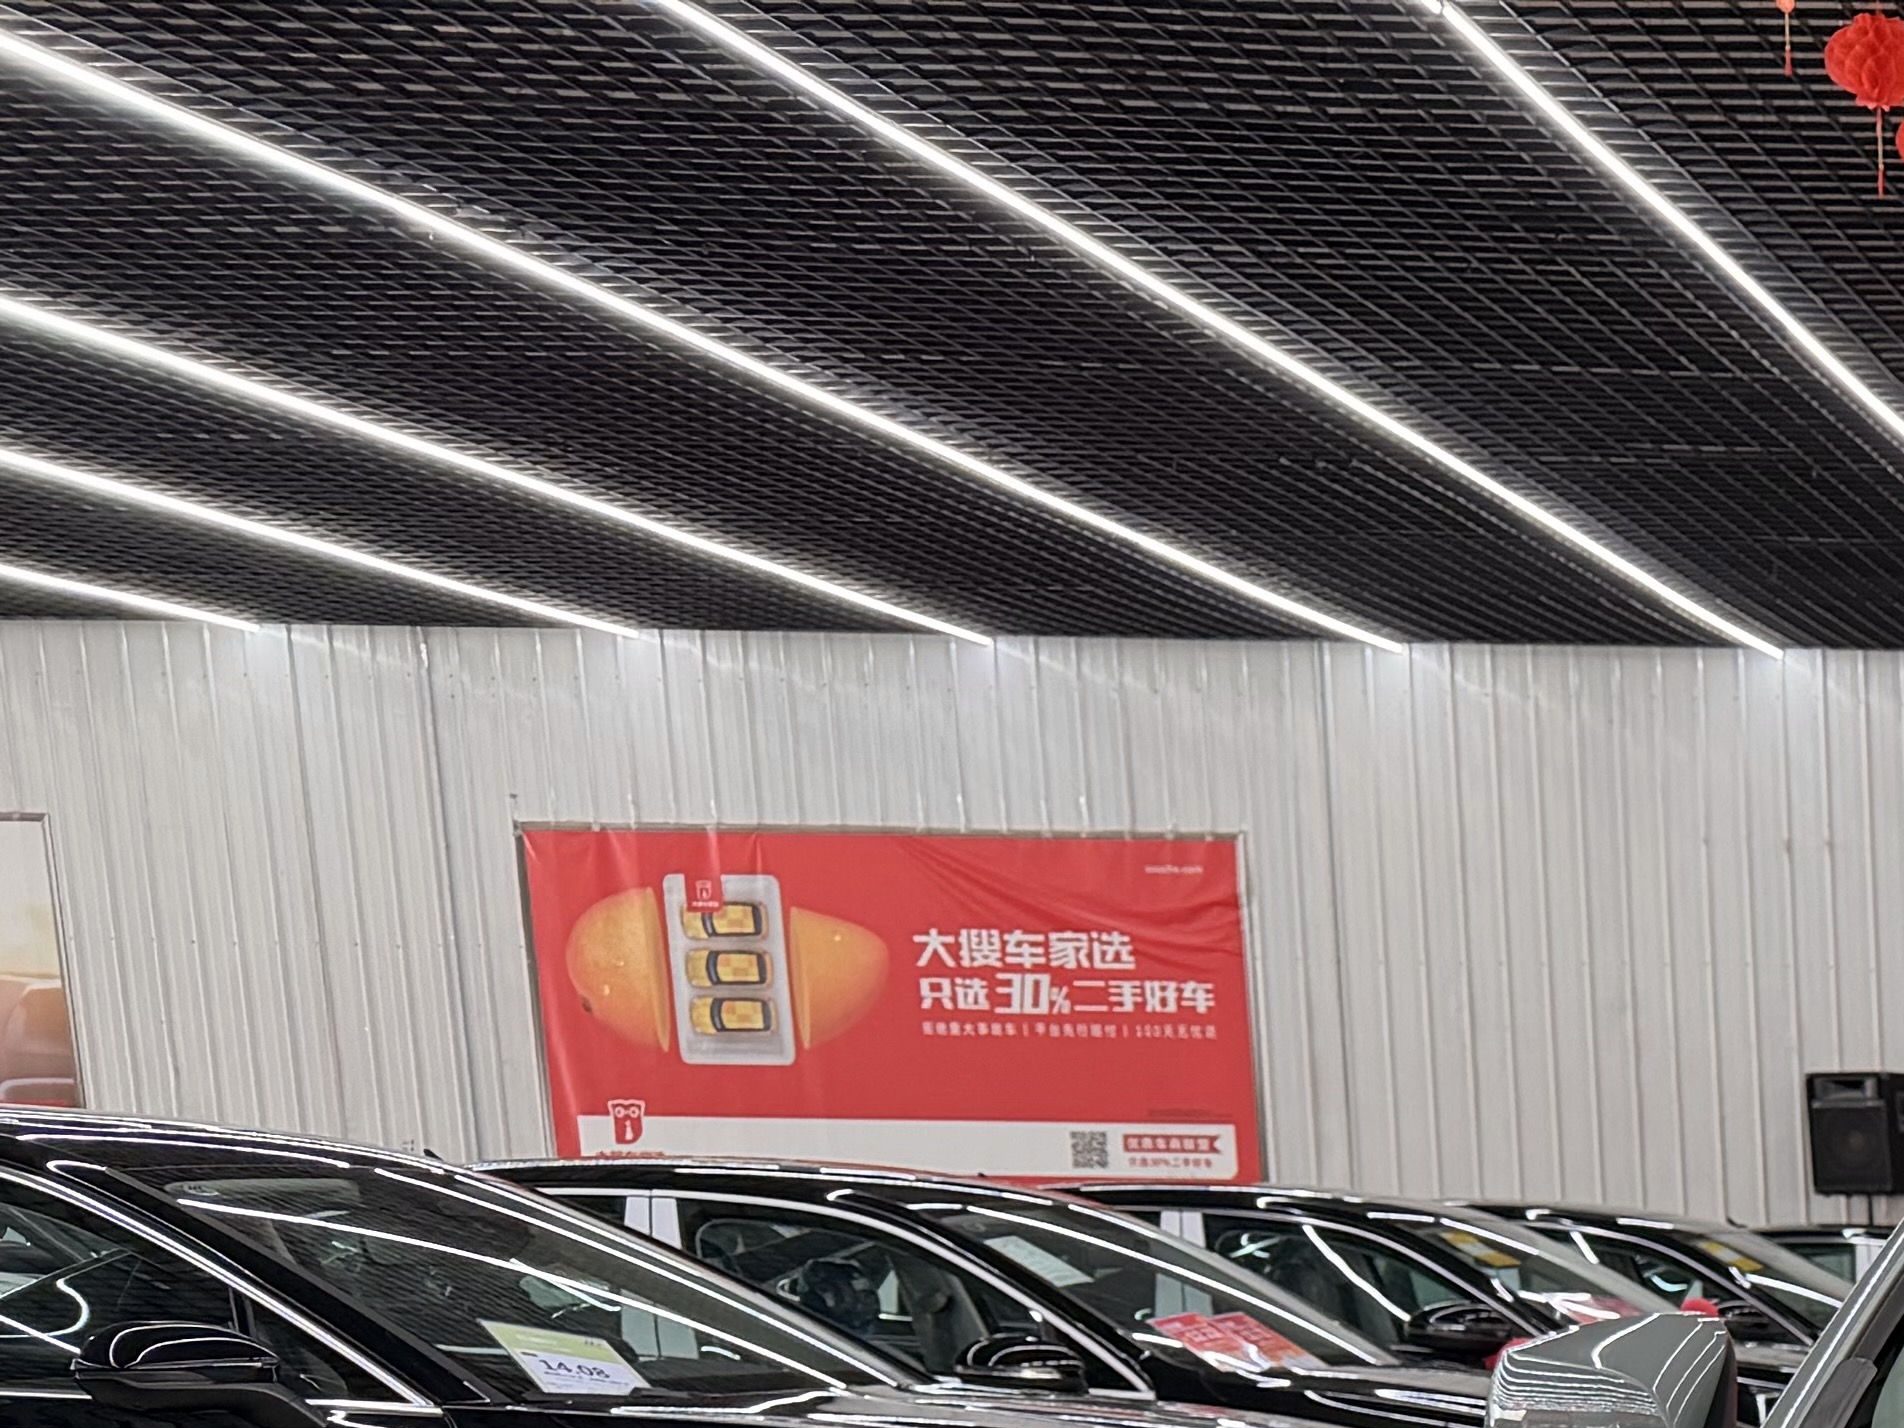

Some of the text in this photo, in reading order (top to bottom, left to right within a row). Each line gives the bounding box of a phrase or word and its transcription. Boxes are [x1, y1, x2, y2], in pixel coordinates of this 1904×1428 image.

[912, 927, 1137, 969] 大搜车家选
[919, 972, 1217, 1015] 只选30%二手好车
[537, 1358, 612, 1380] 14.08
